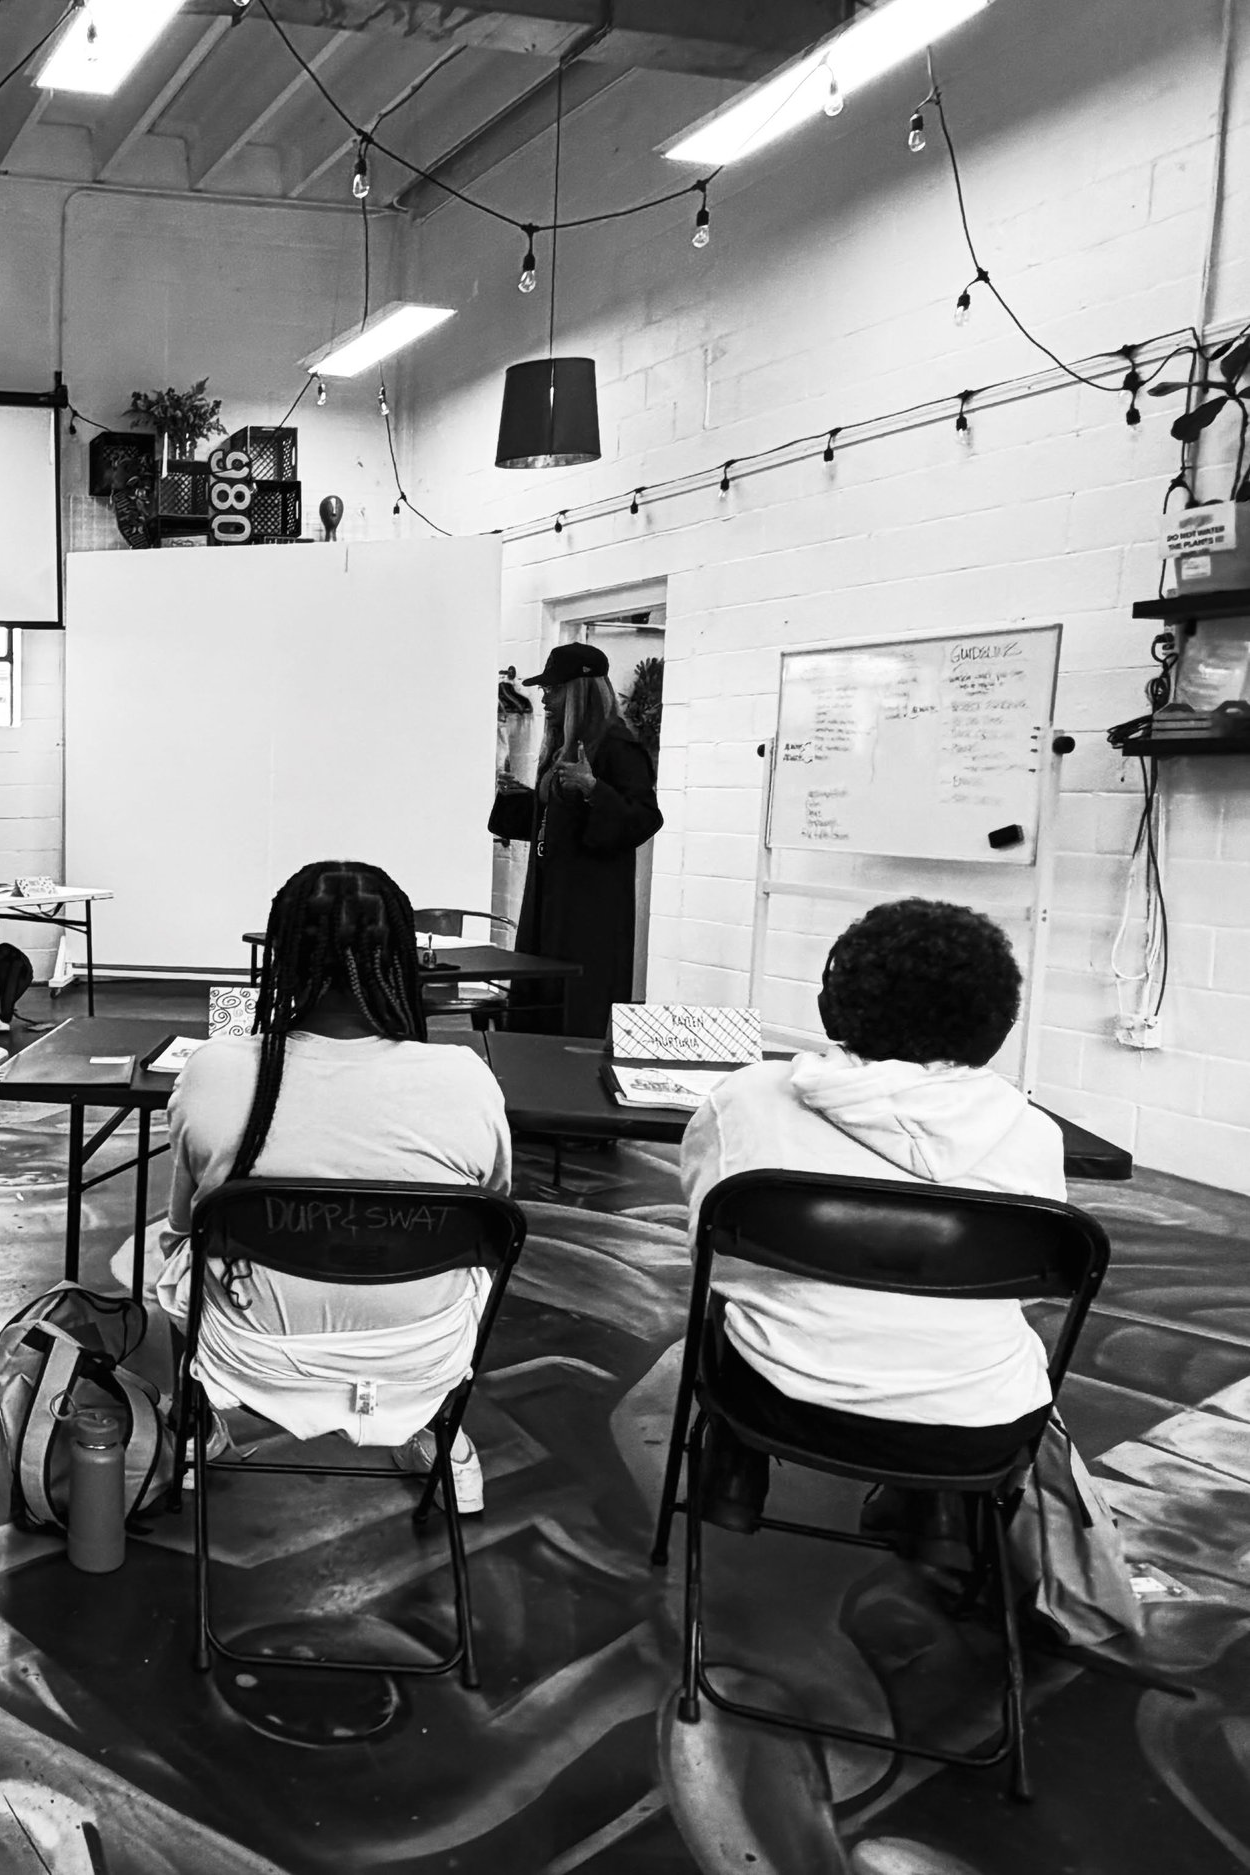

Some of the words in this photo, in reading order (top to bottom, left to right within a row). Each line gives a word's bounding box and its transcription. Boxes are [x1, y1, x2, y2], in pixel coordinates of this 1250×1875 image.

[1180, 530, 1196, 539] NOT
[1197, 525, 1225, 536] WATER
[1183, 537, 1214, 549] PLANTS
[365, 1205, 459, 1234] SWAT
